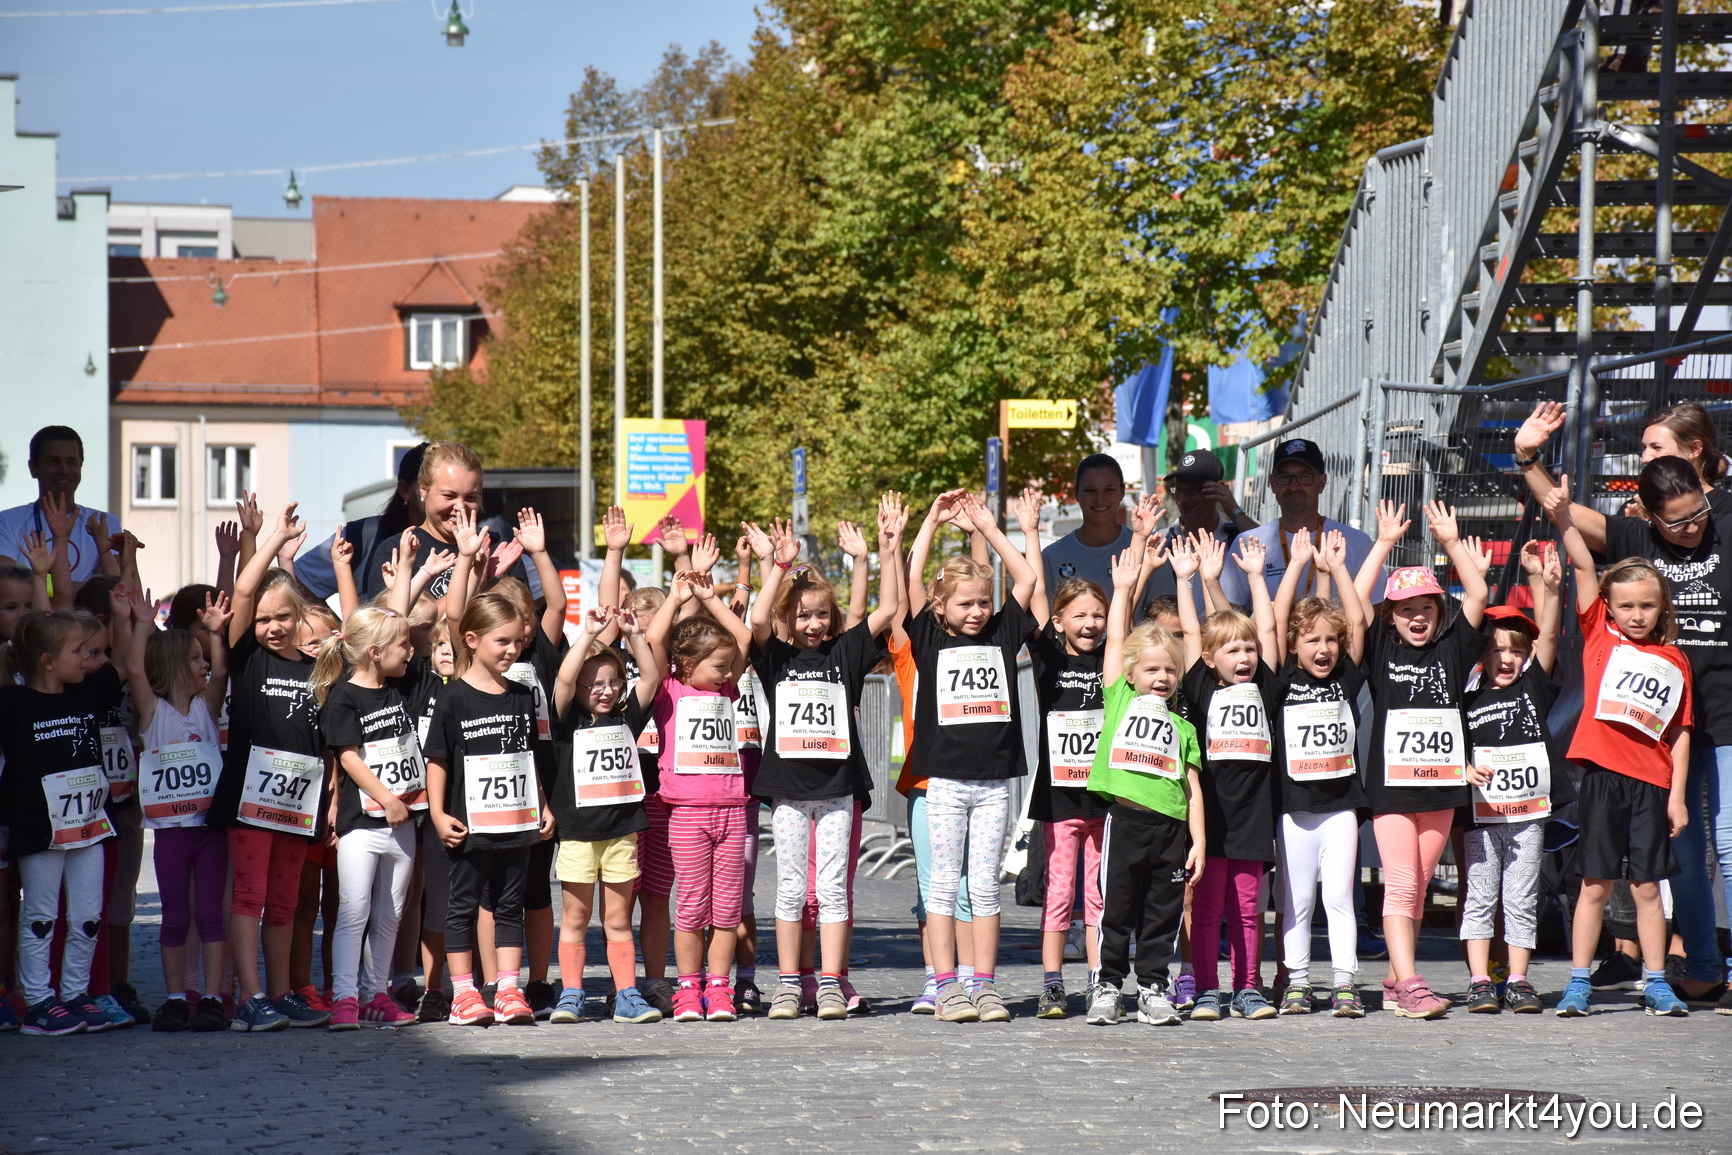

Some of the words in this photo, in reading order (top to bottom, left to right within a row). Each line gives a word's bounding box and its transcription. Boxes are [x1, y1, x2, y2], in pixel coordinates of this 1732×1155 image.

[1009, 408, 1063, 420] Toiletten
[1653, 553, 1720, 574] NEUMARKTER
[266, 677, 308, 689] umarkter
[947, 666, 1000, 692] 7432
[1616, 670, 1672, 707] 7094
[788, 702, 835, 726] 7431
[963, 704, 992, 715] Emma
[1219, 704, 1264, 729] 7501
[1467, 701, 1517, 719] Neumarkter
[460, 714, 514, 730] Neumarkter
[1066, 717, 1096, 727] BOCK
[1468, 710, 1508, 730] Stadtlauf
[34, 727, 78, 742] Stadtlauf
[463, 725, 506, 740] Stadtlauf
[688, 717, 732, 741] 7500
[1124, 715, 1173, 746] 7073
[1297, 722, 1348, 748] 7535
[802, 739, 828, 749] Luise
[1212, 740, 1250, 750] ISABELLA
[1396, 731, 1454, 755] 7349
[160, 749, 197, 761] BOCK
[586, 746, 634, 773] 7552
[703, 754, 725, 765] Julia
[1124, 751, 1164, 768] Mathilda
[1492, 752, 1527, 763] BOCK
[273, 757, 307, 772] BOCK
[369, 755, 420, 785] 7360
[67, 773, 98, 787] BOCK
[151, 762, 212, 792] 7099
[1068, 768, 1090, 779] Patri
[1413, 768, 1439, 778] Karla
[258, 770, 311, 801] 7347
[478, 774, 527, 801] 7517
[176, 790, 202, 798] Neumarkt
[59, 788, 103, 818] 7110
[171, 802, 198, 814] Viola
[1496, 803, 1529, 815] Liliane
[256, 807, 299, 825] Franziska
